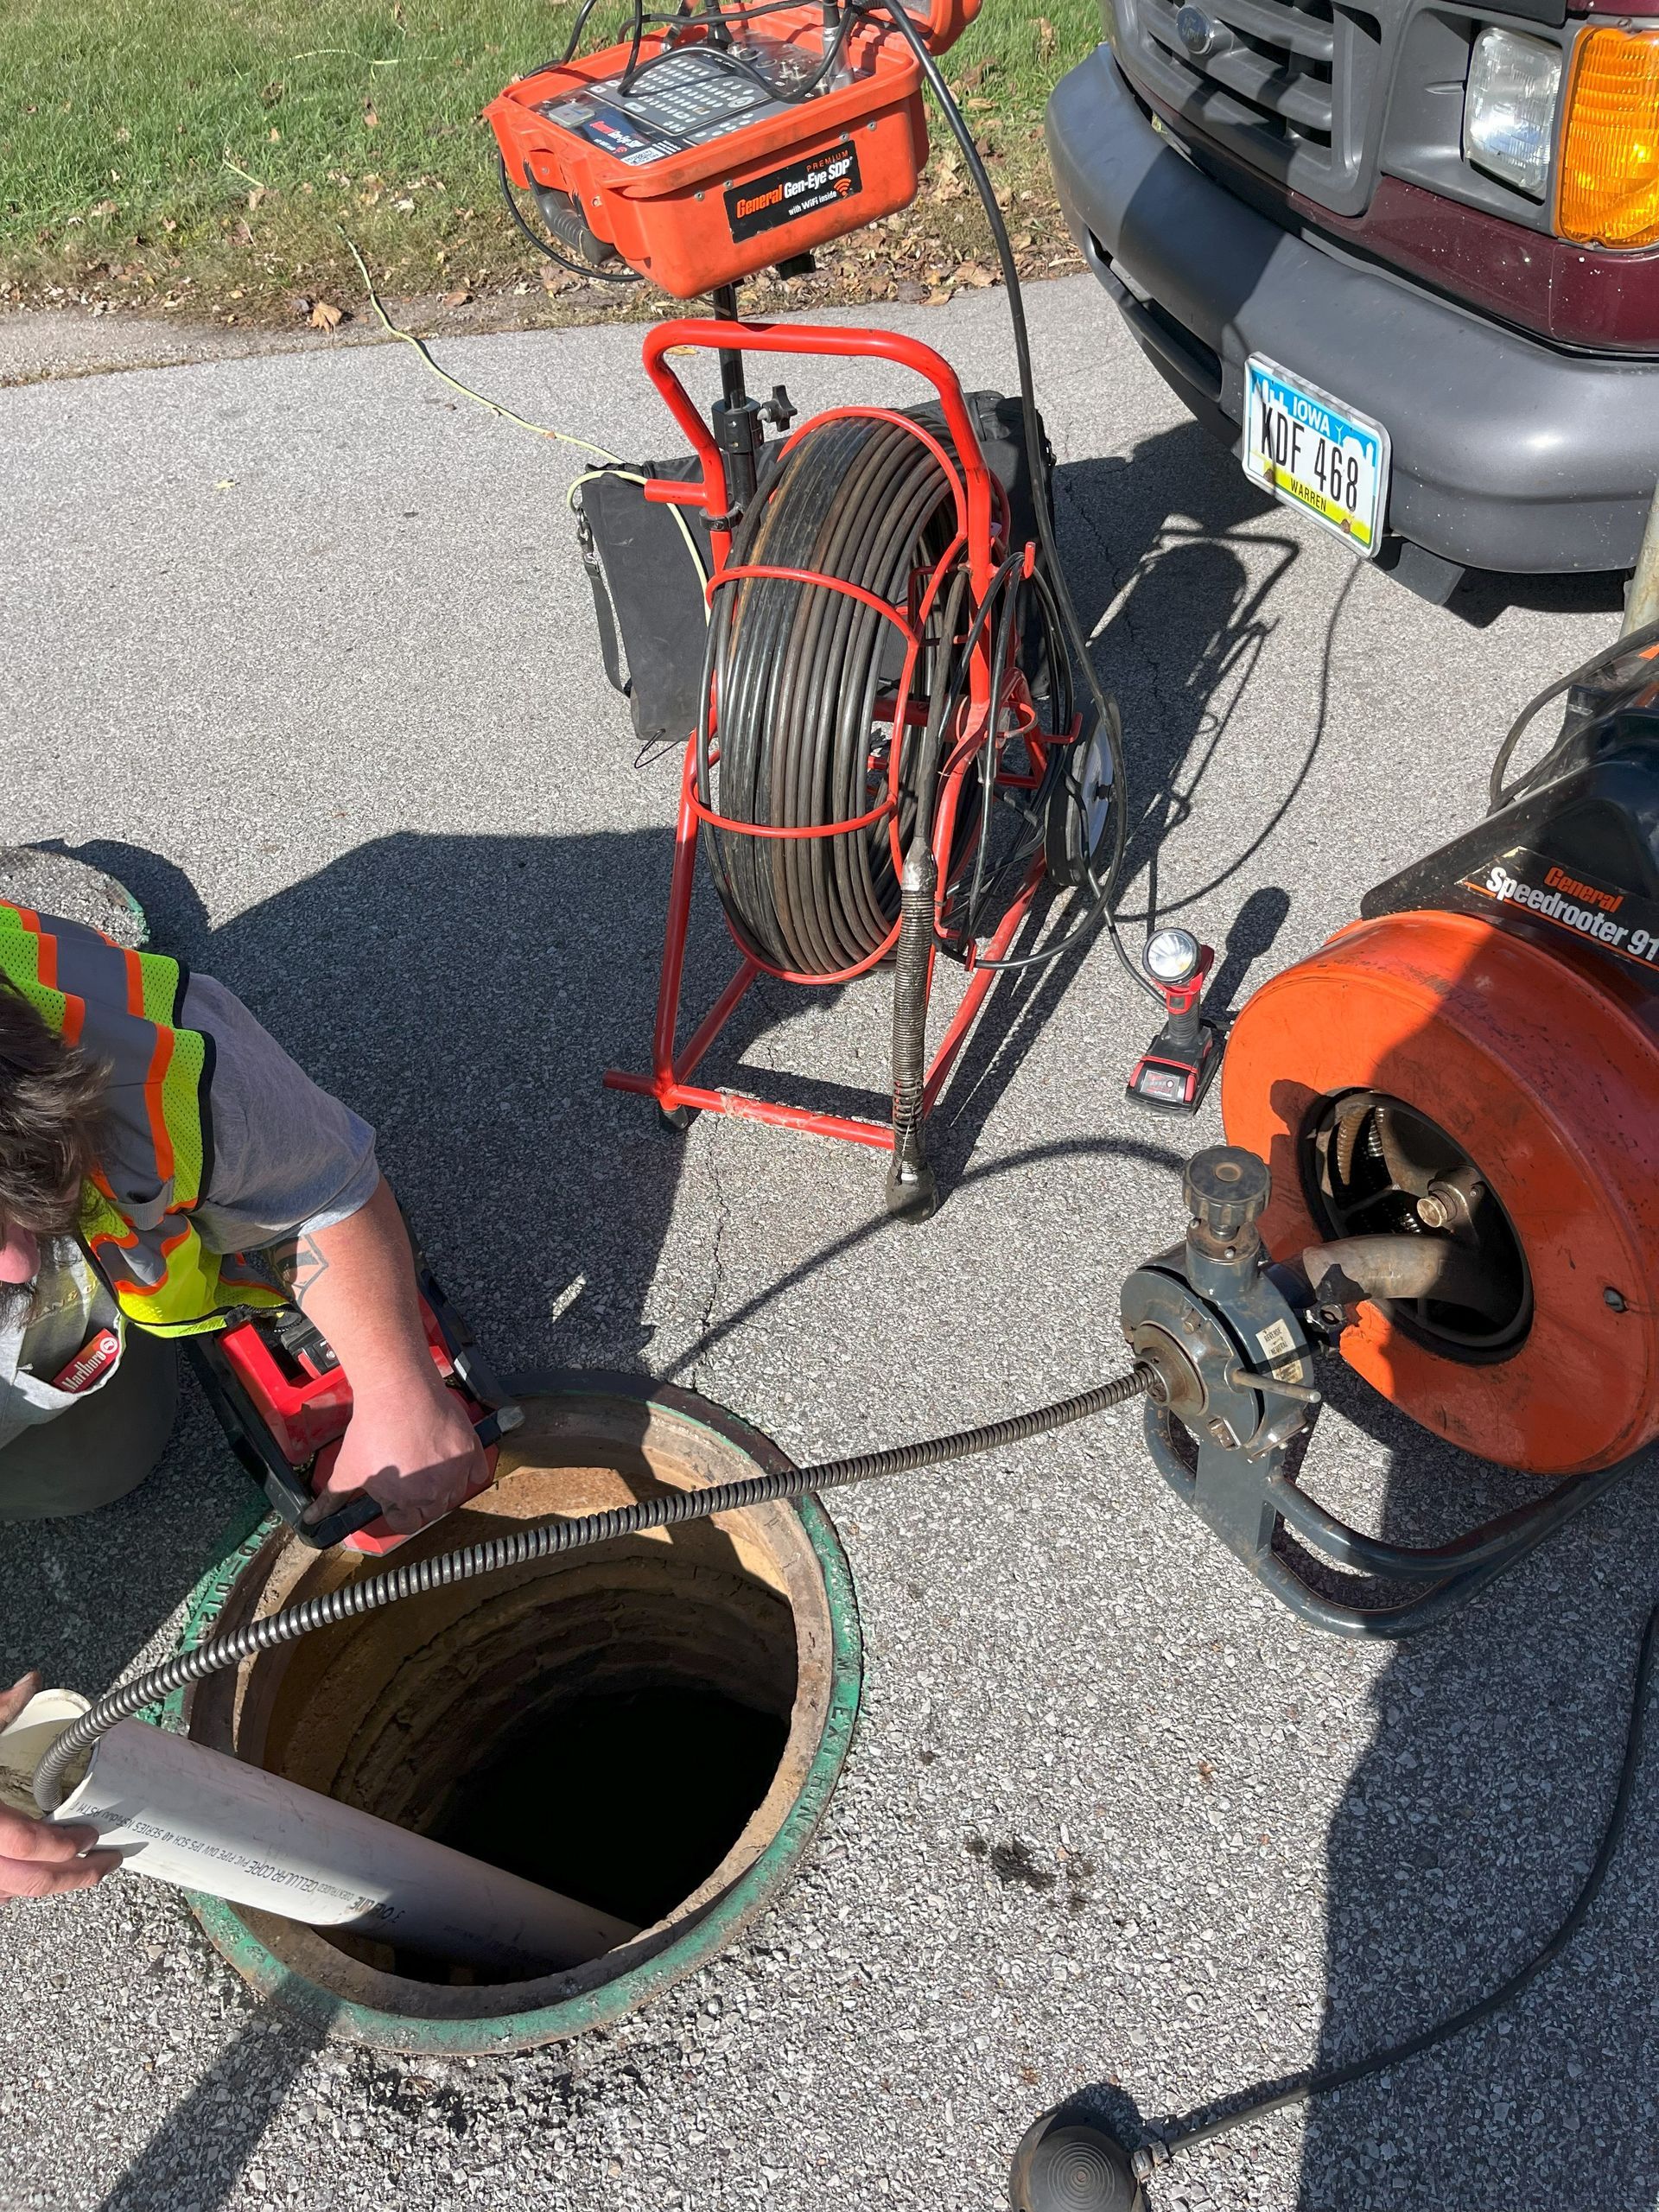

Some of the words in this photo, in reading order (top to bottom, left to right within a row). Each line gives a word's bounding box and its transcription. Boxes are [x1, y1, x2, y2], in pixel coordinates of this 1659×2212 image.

[806, 149, 849, 172] PREMIUM
[736, 184, 783, 219] General
[784, 171, 827, 199] Gen-Eye
[788, 205, 802, 216] with
[801, 196, 819, 211] WiFi
[818, 189, 837, 203] inside
[1293, 396, 1331, 437] IOWA
[1262, 402, 1305, 474] KDF
[1313, 437, 1358, 512] 468
[1291, 477, 1326, 512] WARREN
[1543, 866, 1624, 913] General
[1485, 867, 1629, 946] Speedrooter
[1627, 929, 1659, 961] 91
[1264, 1328, 1282, 1342] REVERSE
[1270, 1342, 1288, 1356] NEUTRAL
[62, 1351, 107, 1392] Marlboro
[77, 1802, 100, 1817] ASTM
[132, 1822, 162, 1840] SERIES
[162, 1831, 174, 1842] 40
[174, 1835, 191, 1847] SCH
[188, 1839, 204, 1853] IPS
[216, 1847, 234, 1863] PIPE
[234, 1855, 249, 1867] PVC
[245, 1859, 275, 1883] CORE
[271, 1869, 319, 1893] CELLULAR
